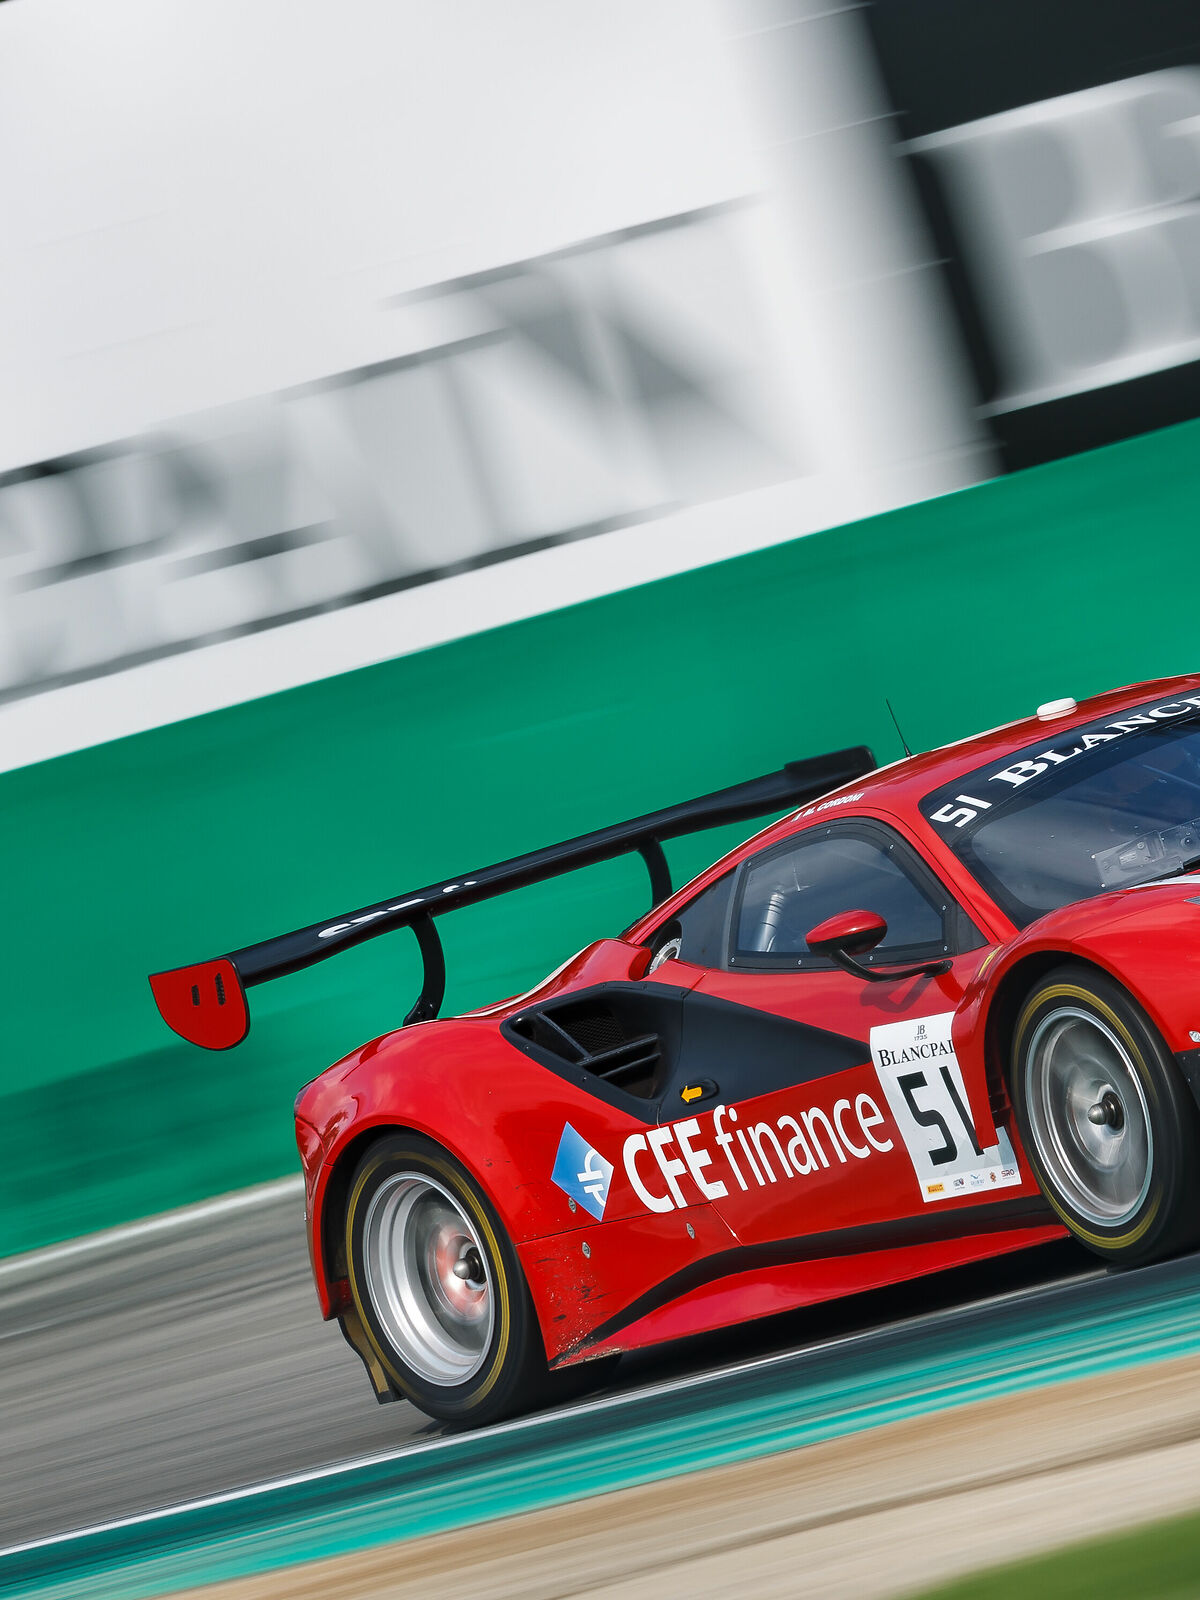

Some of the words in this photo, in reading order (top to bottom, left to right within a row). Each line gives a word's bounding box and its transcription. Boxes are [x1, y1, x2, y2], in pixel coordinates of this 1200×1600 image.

[929, 794, 992, 828] 51
[877, 1039, 956, 1068] BLANCPAI
[896, 1065, 985, 1166] 51
[622, 1117, 729, 1213] CFE
[712, 1092, 895, 1192] finance
